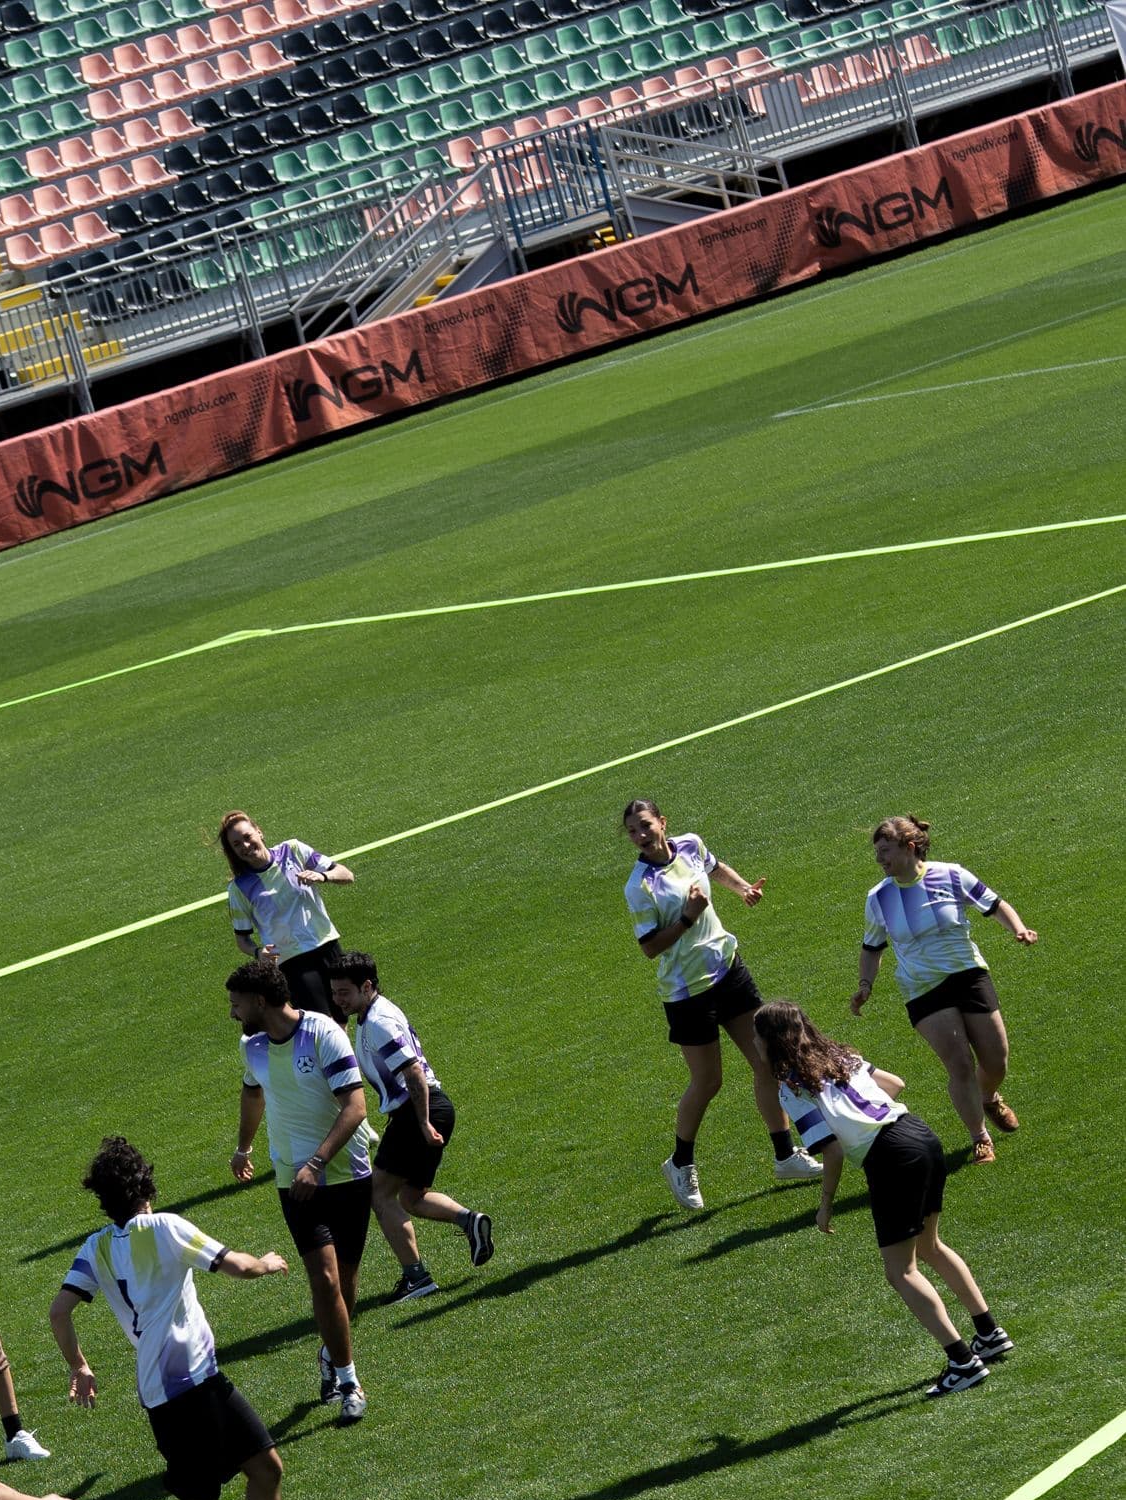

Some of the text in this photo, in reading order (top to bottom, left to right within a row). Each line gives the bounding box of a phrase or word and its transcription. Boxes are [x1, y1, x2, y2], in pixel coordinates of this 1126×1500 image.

[697, 217, 767, 247] ngmadv.com
[816, 176, 954, 247] NGM
[556, 263, 700, 334] NGM
[285, 350, 426, 421] NGM
[14, 441, 167, 518] NGM
